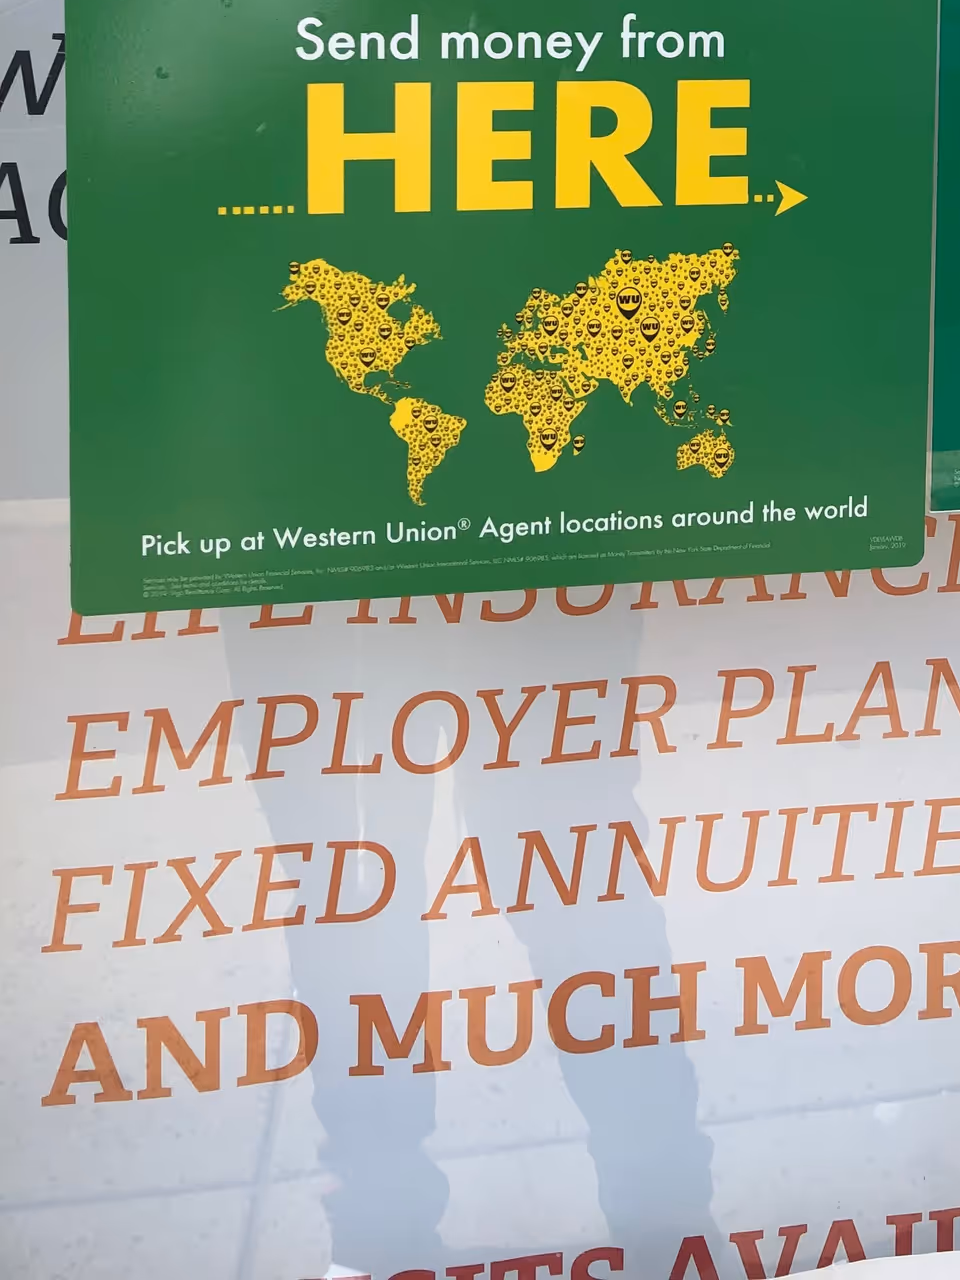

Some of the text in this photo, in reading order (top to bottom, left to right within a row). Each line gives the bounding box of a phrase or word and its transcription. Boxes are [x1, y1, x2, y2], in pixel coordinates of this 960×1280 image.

[295, 13, 725, 72] Send money from
[307, 79, 751, 214] HERE
[142, 533, 191, 557] Pick
[200, 538, 231, 559] up
[240, 531, 266, 552] at
[272, 526, 377, 550] Western
[479, 517, 552, 543] Agent
[559, 511, 664, 535] locations
[671, 500, 754, 528] around
[762, 499, 796, 523] the
[804, 495, 869, 519] world
[54, 673, 681, 803] EMPLOYER
[41, 839, 397, 955] FIXED
[40, 997, 320, 1108] AND
[347, 961, 710, 1078] MUCH
